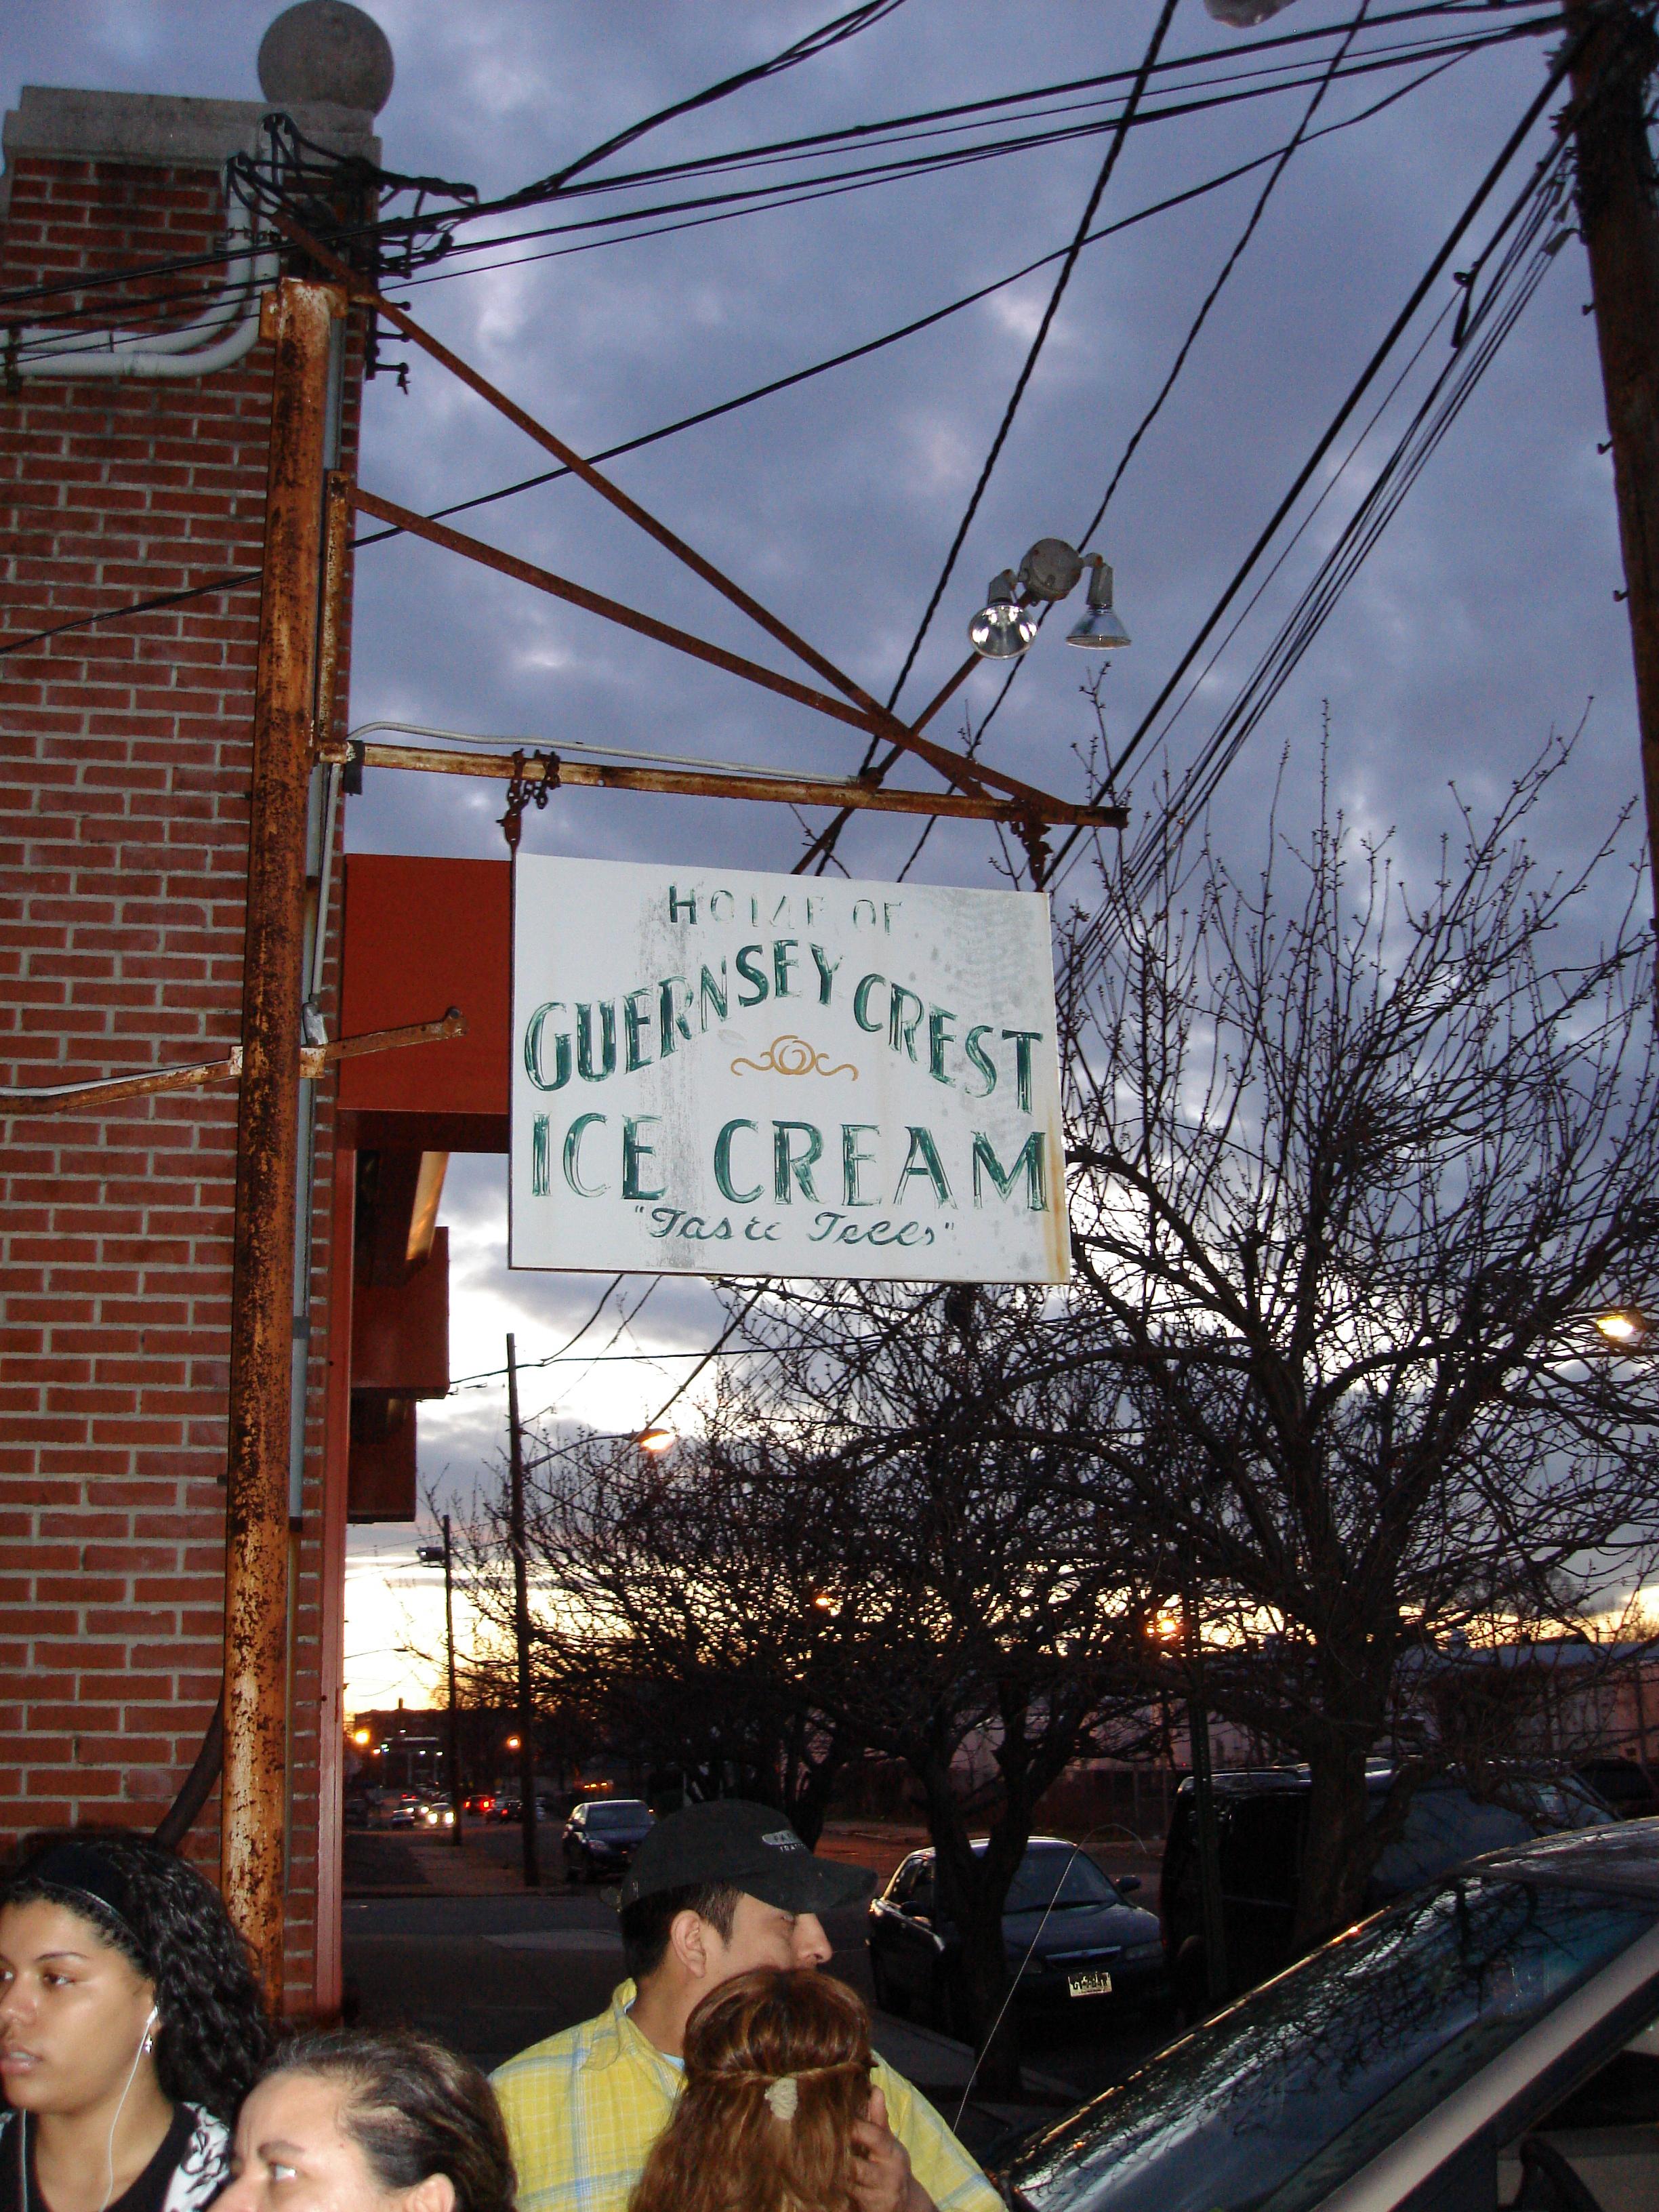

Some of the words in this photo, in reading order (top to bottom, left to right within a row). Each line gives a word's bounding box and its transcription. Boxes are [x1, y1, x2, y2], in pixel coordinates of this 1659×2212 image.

[525, 939, 844, 1091] GUERNSEY
[853, 973, 1044, 1115] CREST
[532, 1111, 668, 1200] ICE
[714, 1118, 1049, 1212] CREAM
